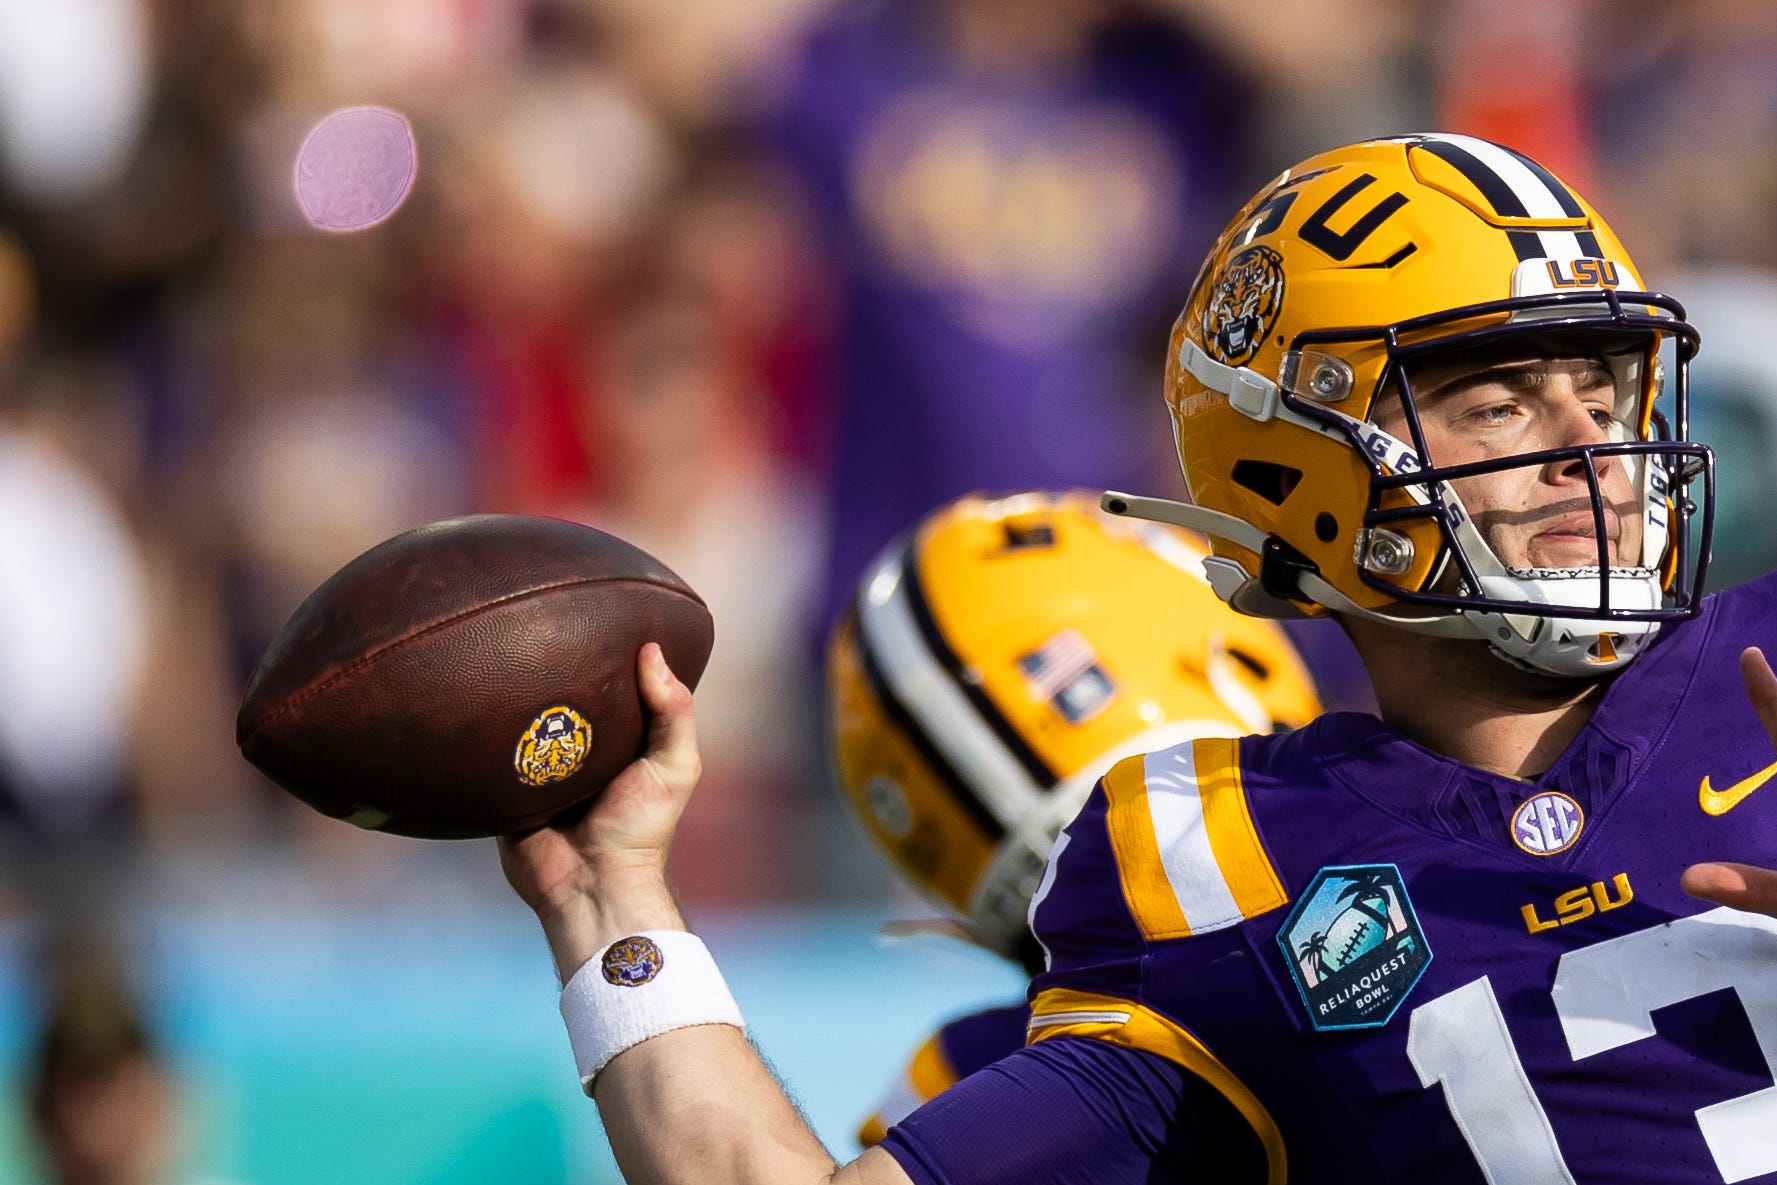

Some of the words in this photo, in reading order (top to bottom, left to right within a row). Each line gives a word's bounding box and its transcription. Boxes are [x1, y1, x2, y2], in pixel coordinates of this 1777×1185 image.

[1545, 259, 1620, 289] LSU
[1517, 795, 1580, 852] SEC
[1520, 872, 1634, 934] LSU
[1319, 953, 1407, 1016] RELIAQUEST
[1355, 984, 1390, 1009] BOWL
